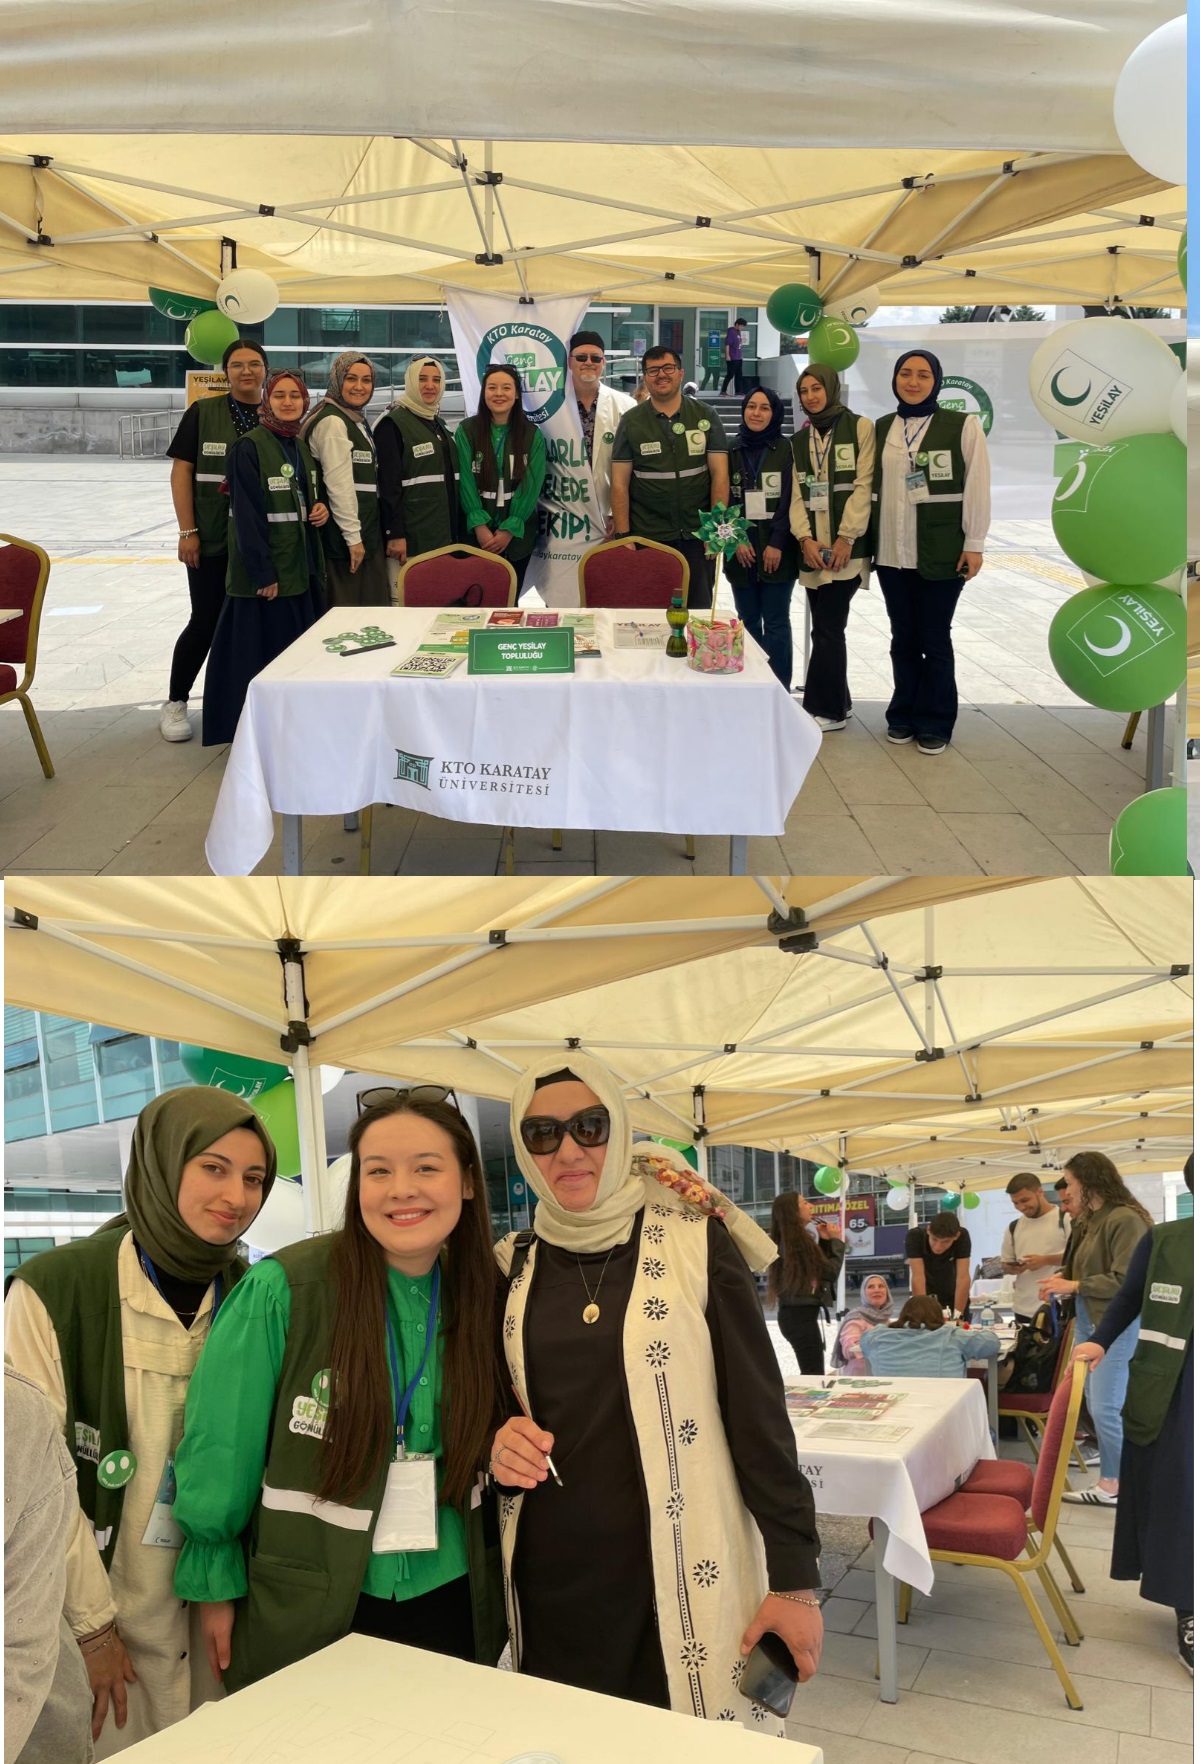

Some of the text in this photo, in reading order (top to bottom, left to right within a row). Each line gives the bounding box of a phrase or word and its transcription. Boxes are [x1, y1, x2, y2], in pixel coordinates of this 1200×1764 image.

[487, 325, 552, 344] KTO Karatay
[506, 355, 533, 368] Genç
[946, 379, 973, 390] Karatay
[939, 400, 965, 411] Genç
[1089, 384, 1123, 425] YEŞİLAY
[1117, 594, 1165, 637] YEŞİLAY
[497, 642, 546, 651] GENÇ YEŞİLAY
[501, 651, 543, 660] TOPLULUĞU
[440, 760, 552, 780] KTO KARATAY
[438, 776, 550, 796] ÜNİVERSİTESİ
[845, 1199, 870, 1211] ÖZEL
